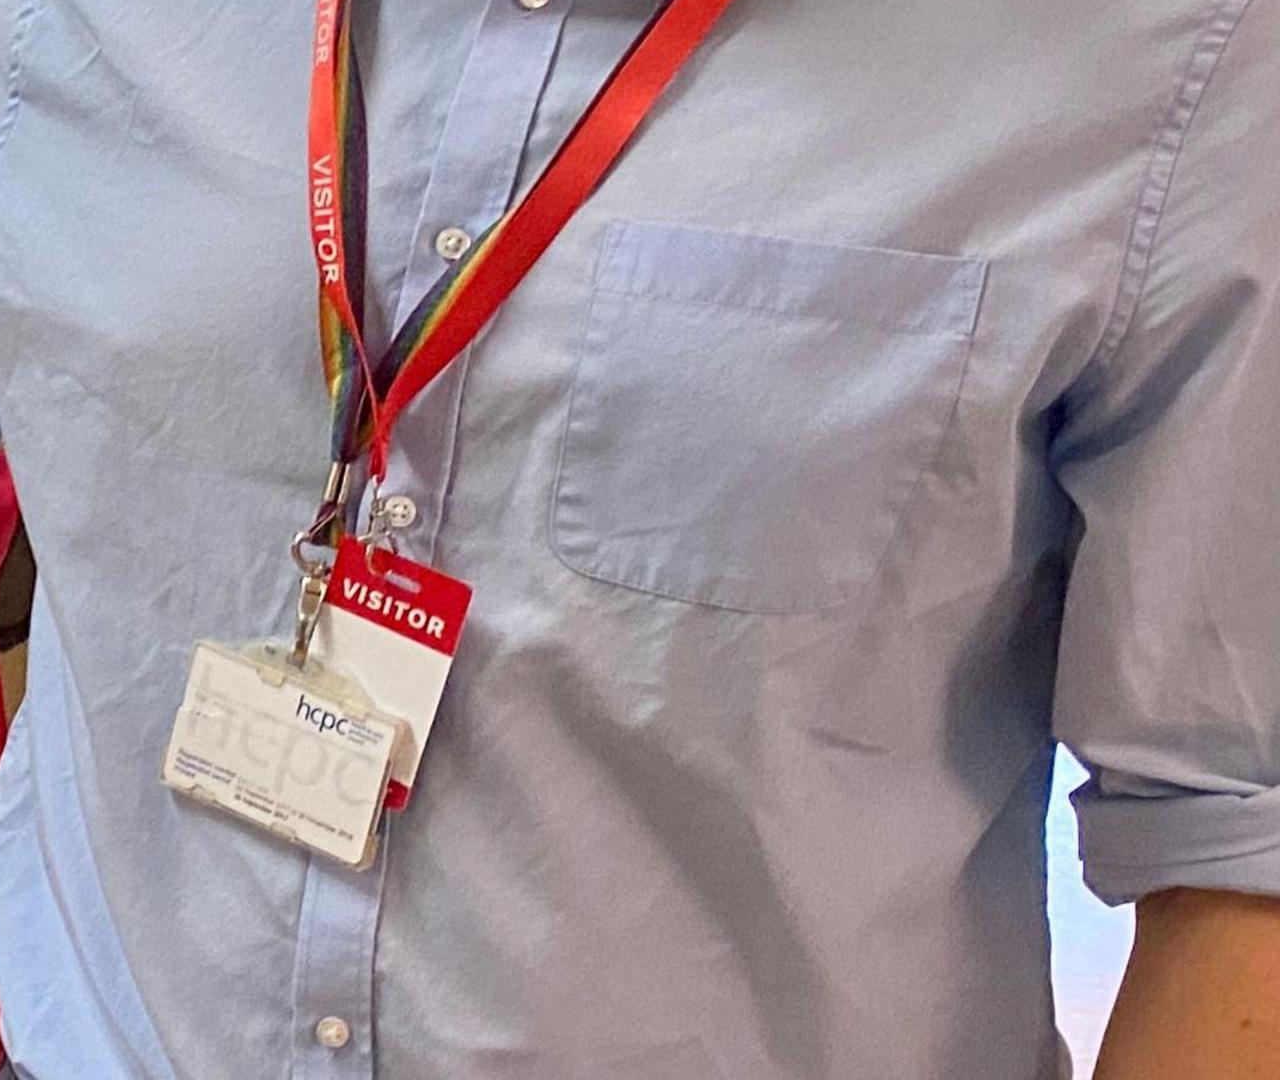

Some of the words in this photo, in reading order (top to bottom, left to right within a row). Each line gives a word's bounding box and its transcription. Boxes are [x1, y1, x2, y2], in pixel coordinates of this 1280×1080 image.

[312, 154, 339, 284] VISITOR
[343, 577, 446, 639] VISITOR
[296, 694, 349, 735] hcpc
